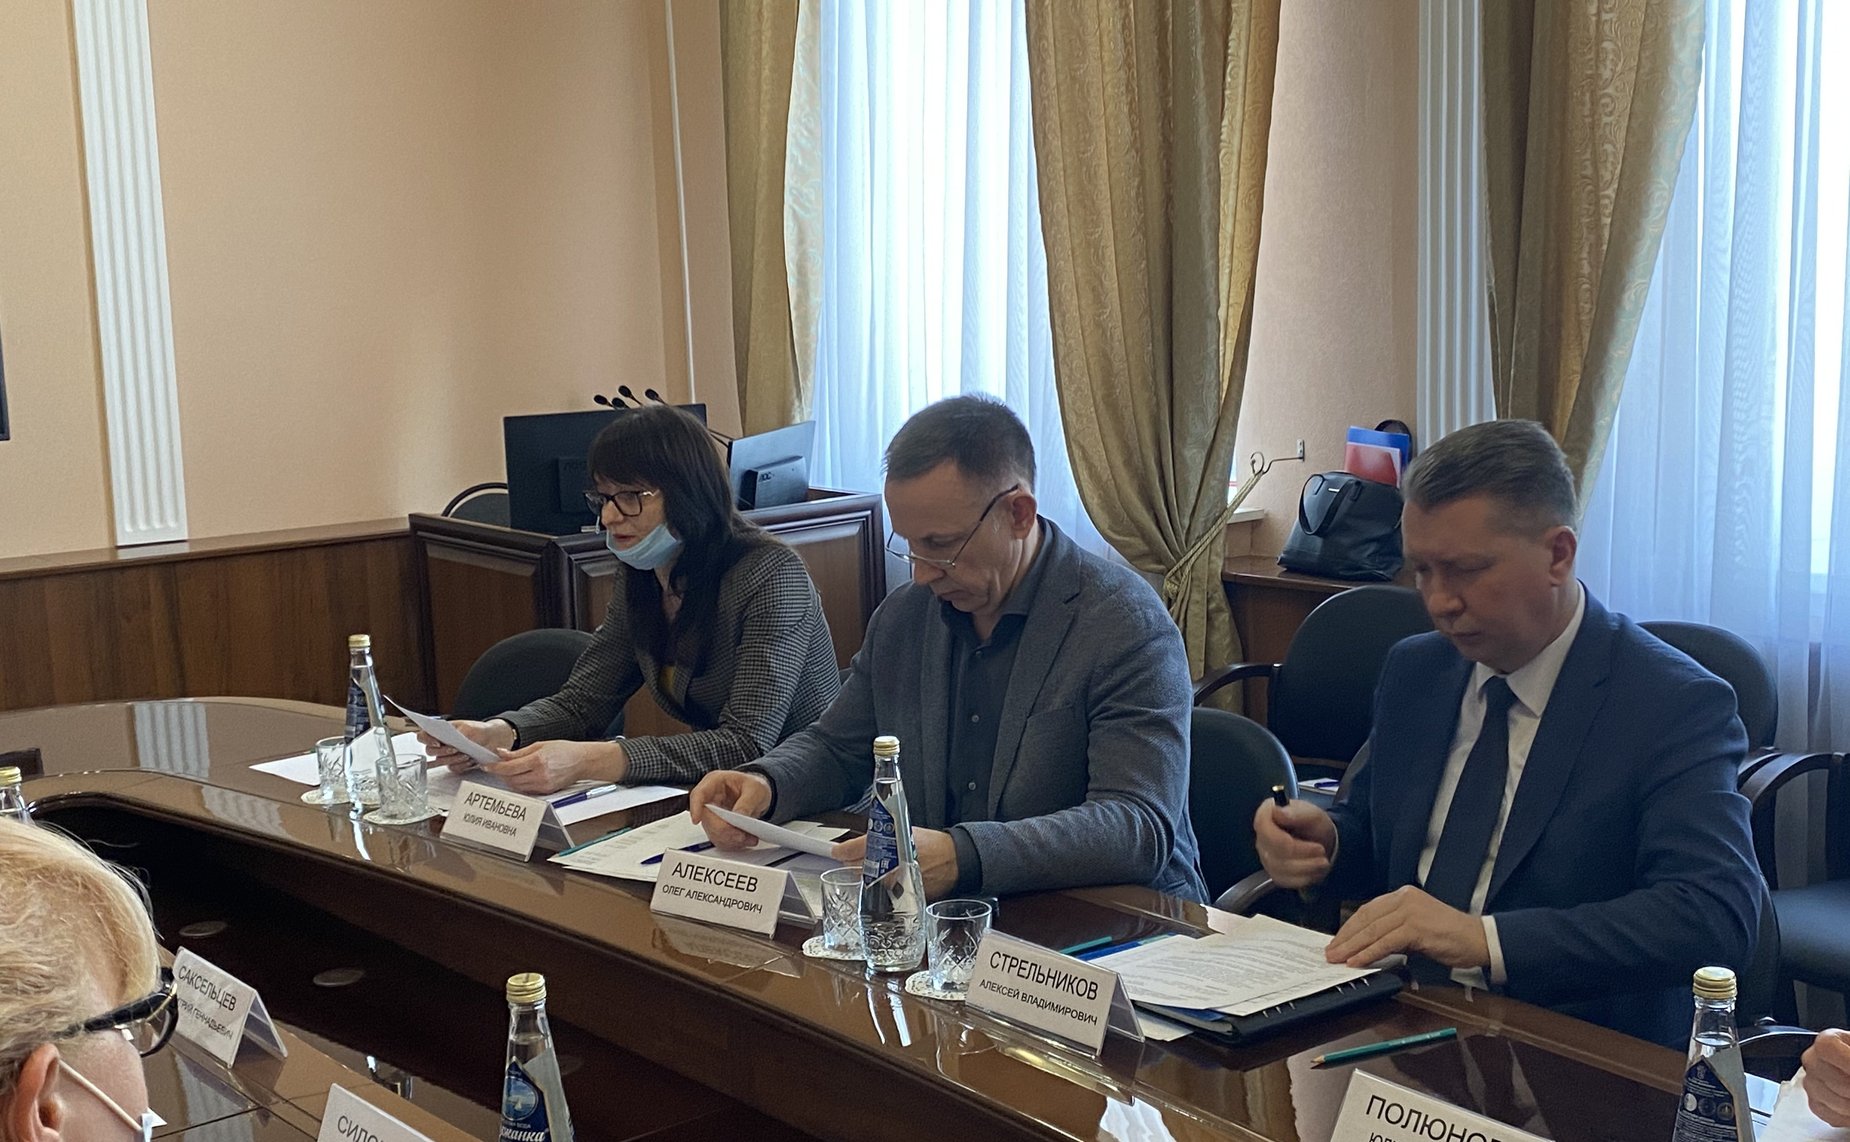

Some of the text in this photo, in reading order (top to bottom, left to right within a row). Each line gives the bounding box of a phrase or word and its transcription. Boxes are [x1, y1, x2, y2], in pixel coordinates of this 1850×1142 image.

[464, 791, 527, 822] АРТЕМЬЕВА
[463, 812, 518, 837] ЮЛИЯ ИВАНОВНА
[671, 862, 758, 893] АЛЕКСЕЕВ
[662, 884, 763, 914] ОЛЕГ АЛЕКСАНДРОВИЧ
[178, 965, 237, 1011] САКСЕЛЬЦЕВ
[989, 951, 1099, 1001] СТРЕЛЬНИКОВ
[178, 998, 194, 1014] ТРИЙ
[979, 978, 1098, 1026] АЛЕКСЕЙ ВЛАДИМИРОВИЧ
[337, 1115, 384, 1142] СИД
[1366, 1094, 1502, 1142] ПОЛЮН
